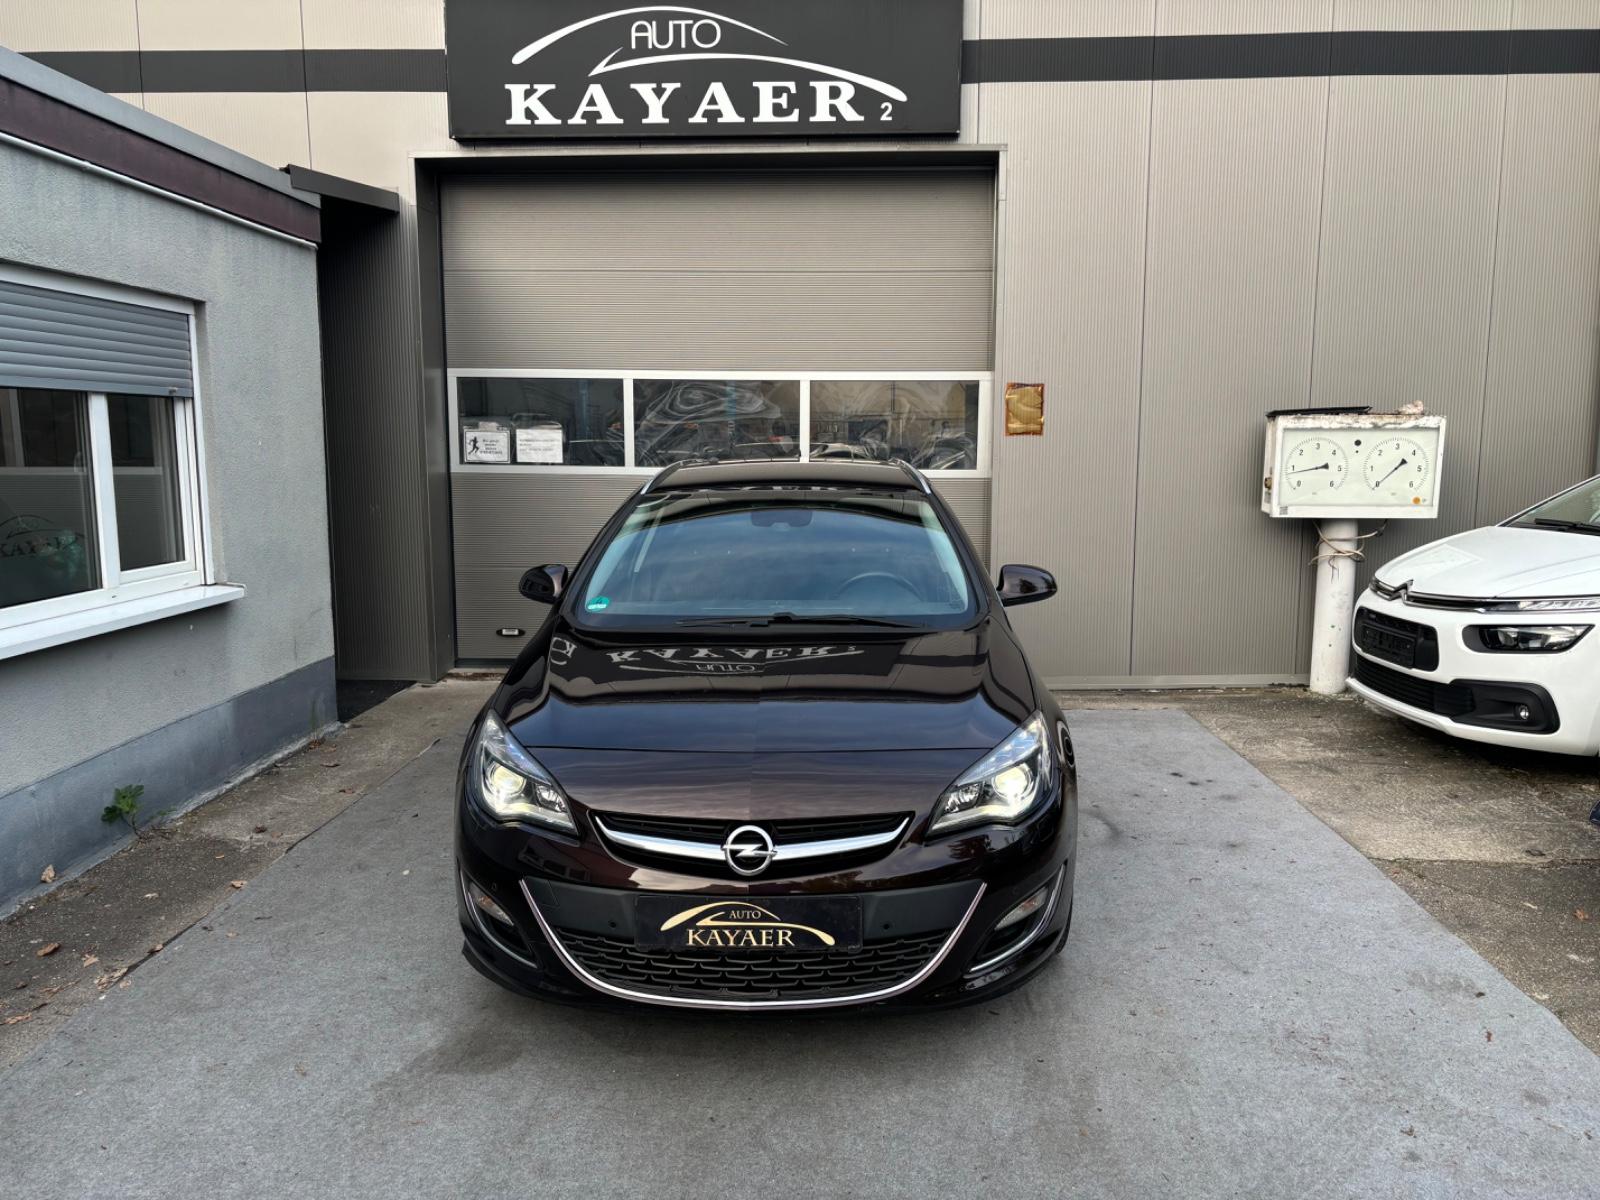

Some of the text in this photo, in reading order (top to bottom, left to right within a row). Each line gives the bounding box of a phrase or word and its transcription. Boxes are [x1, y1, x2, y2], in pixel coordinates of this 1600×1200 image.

[630, 19, 722, 50] AUTO
[504, 82, 893, 125] KAYAER 2
[729, 910, 762, 920] AUTO
[686, 929, 795, 947] KAYAER
